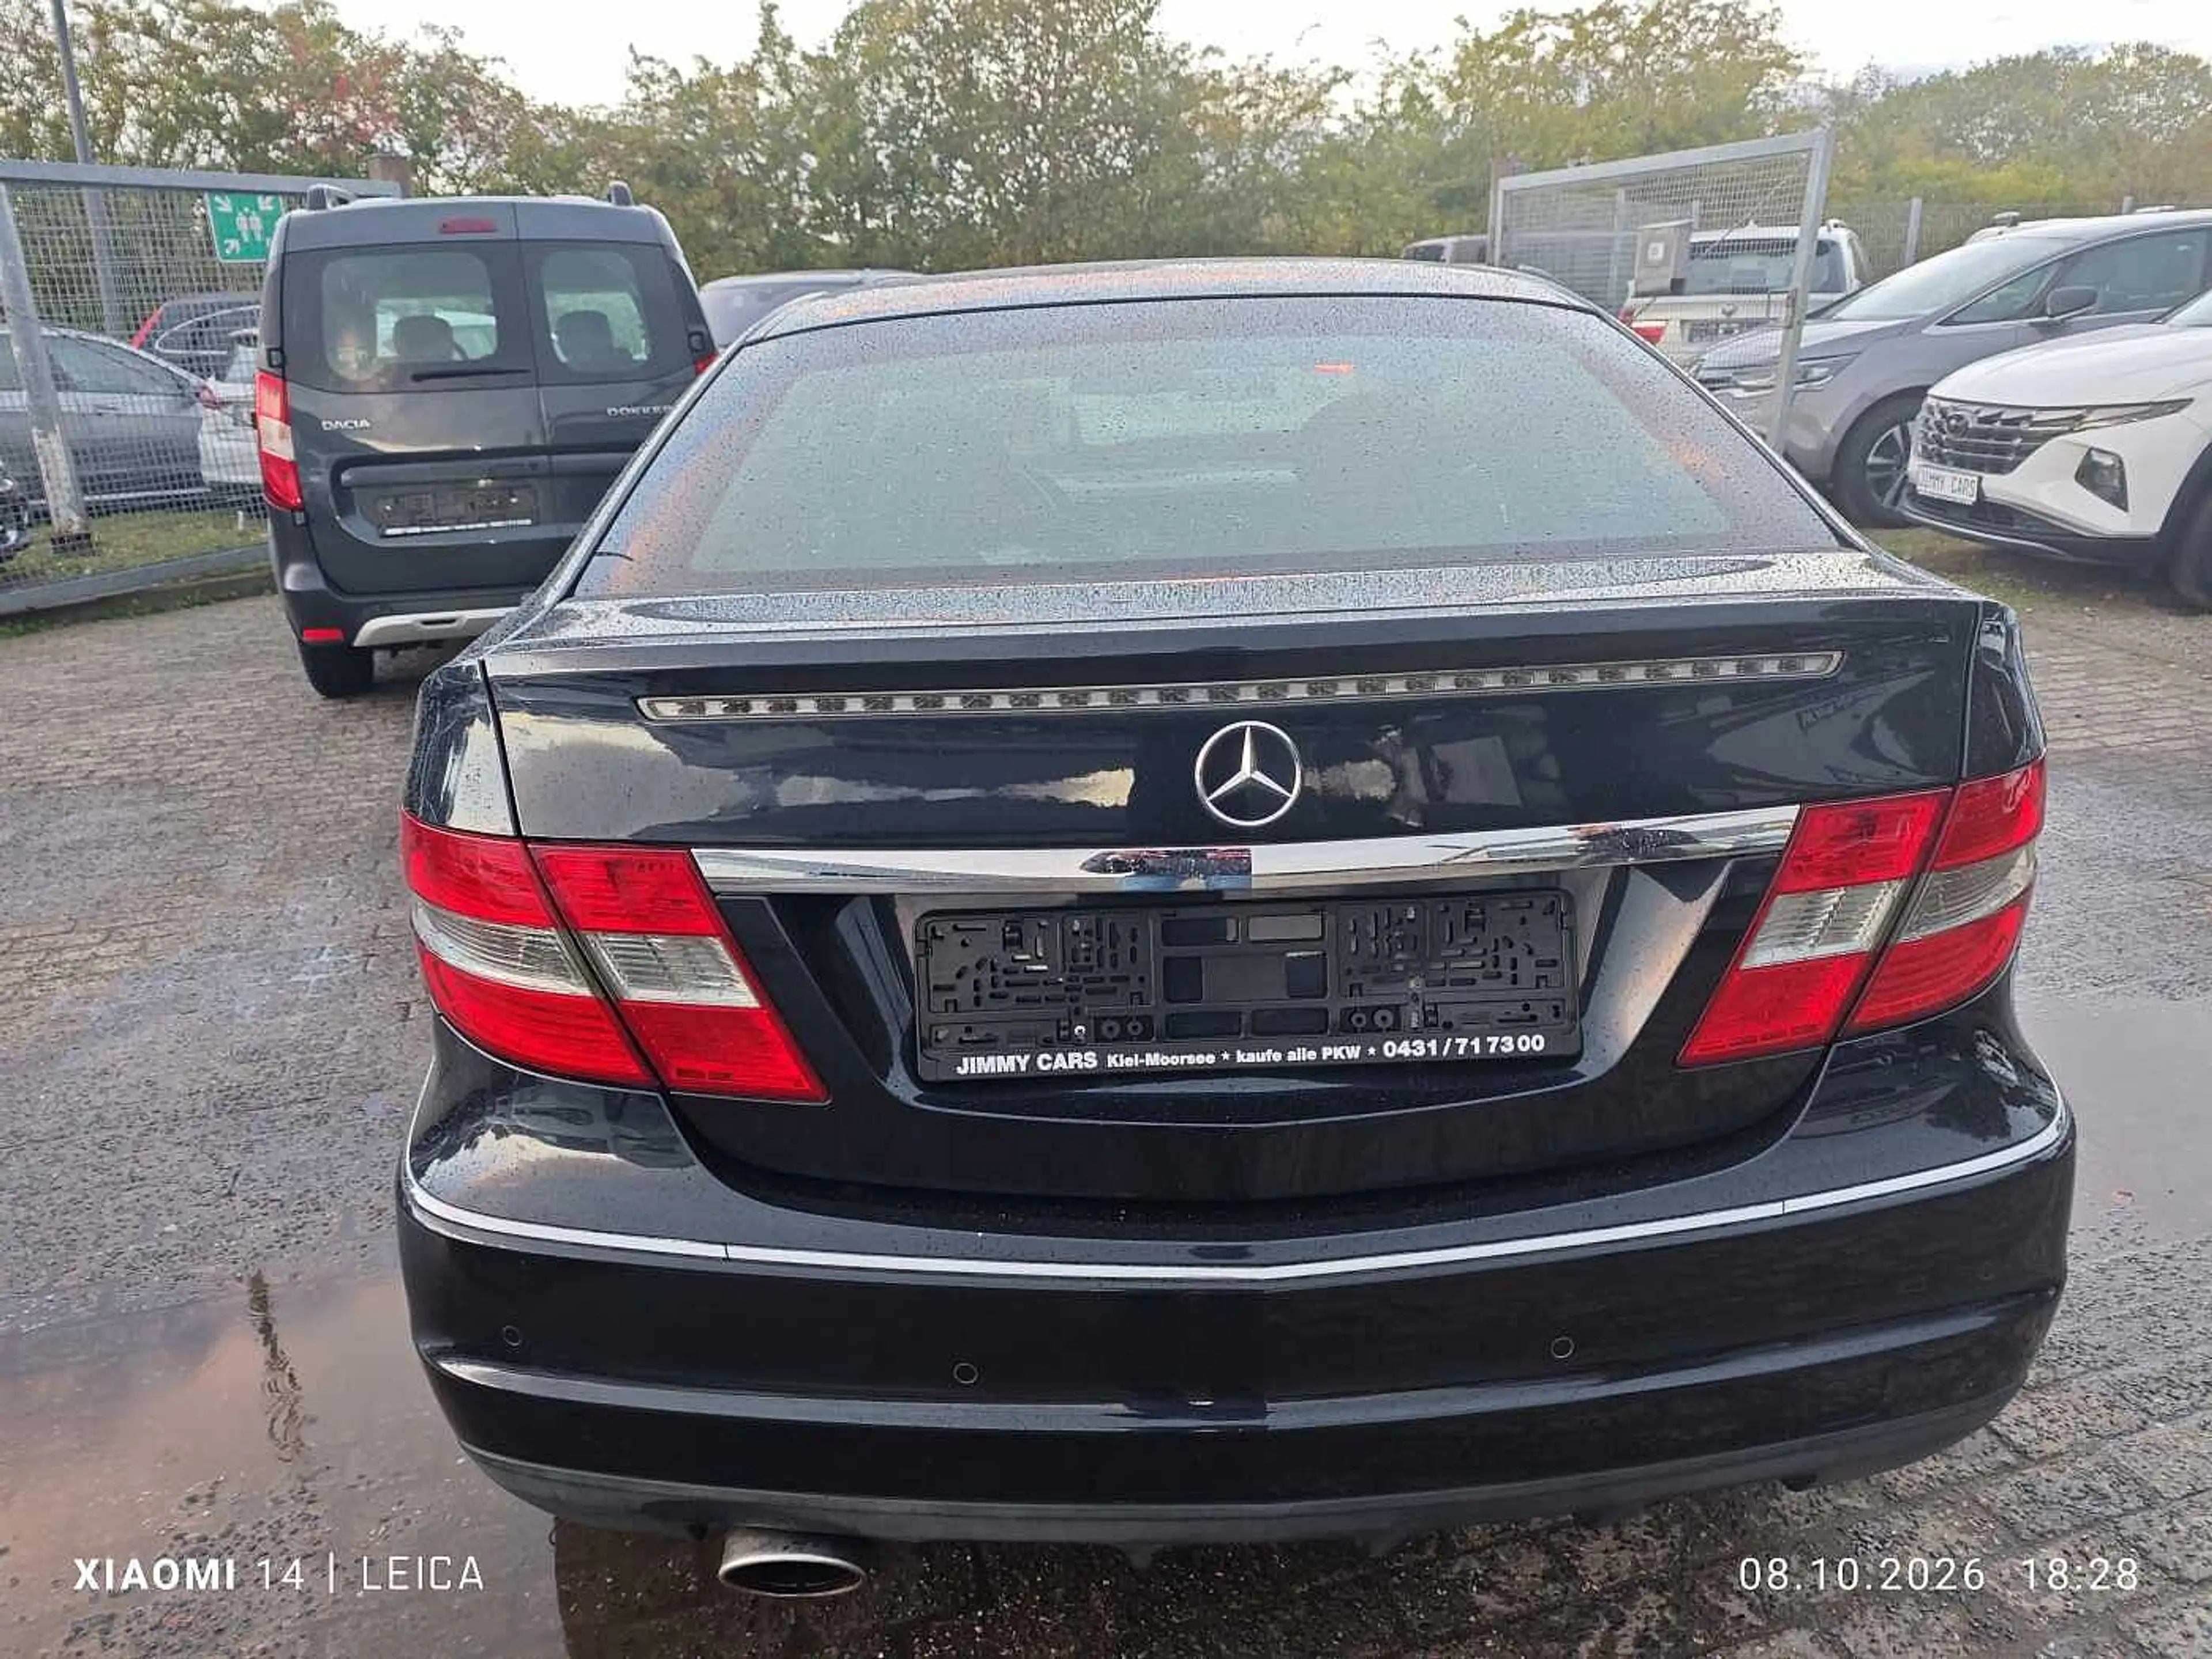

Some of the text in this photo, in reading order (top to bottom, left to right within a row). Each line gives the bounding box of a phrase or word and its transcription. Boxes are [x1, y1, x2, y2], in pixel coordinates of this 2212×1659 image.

[321, 419, 371, 431] DACIA
[1950, 474, 1976, 498] CARS
[956, 1054, 1031, 1075] JIMMY
[1036, 1050, 1098, 1071] CARS
[1107, 1051, 1215, 1068] Kiel-Moorsee
[1236, 1048, 1282, 1063] kaufe
[1321, 1045, 1361, 1060] PKW
